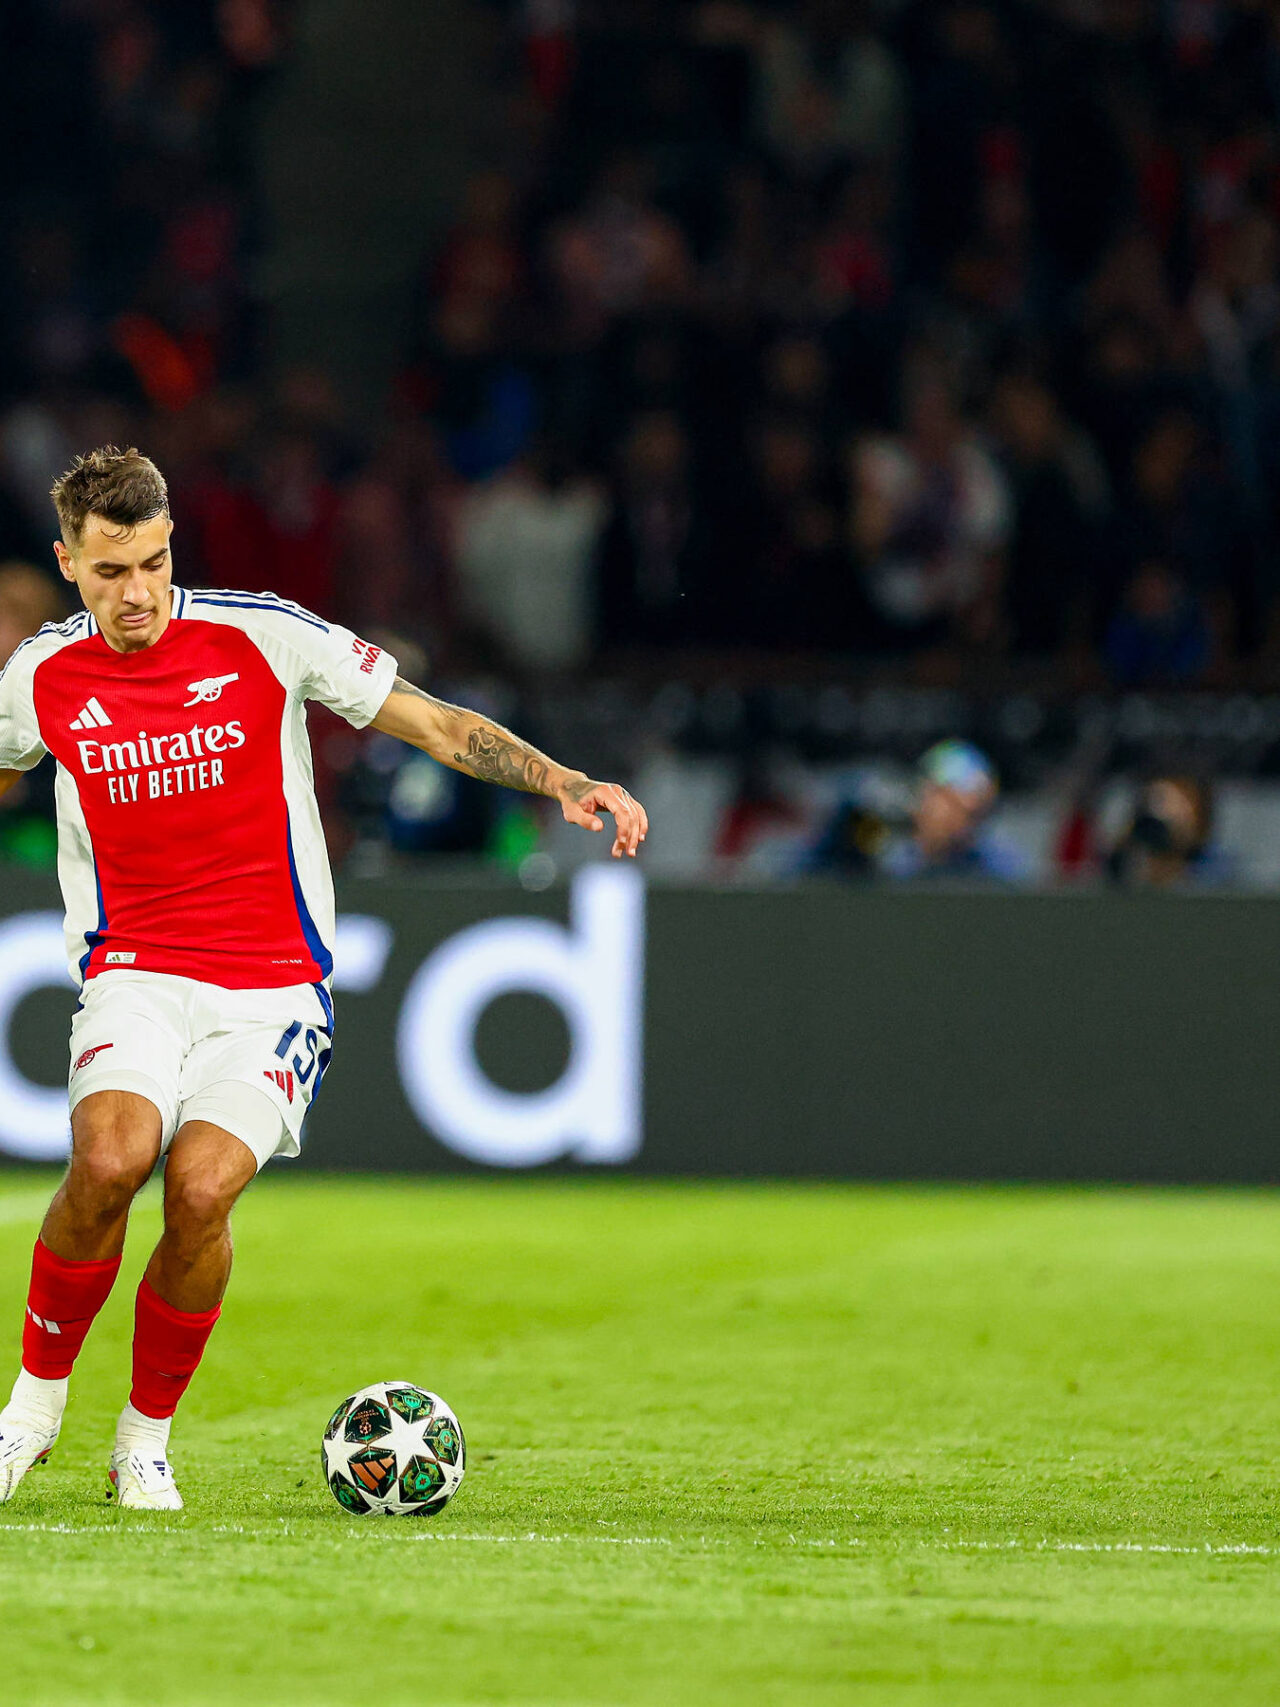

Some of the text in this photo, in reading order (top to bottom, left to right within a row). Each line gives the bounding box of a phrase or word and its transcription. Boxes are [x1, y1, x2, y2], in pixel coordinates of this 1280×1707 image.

[76, 720, 246, 775] Emirates
[107, 758, 225, 804] FLY BETTER
